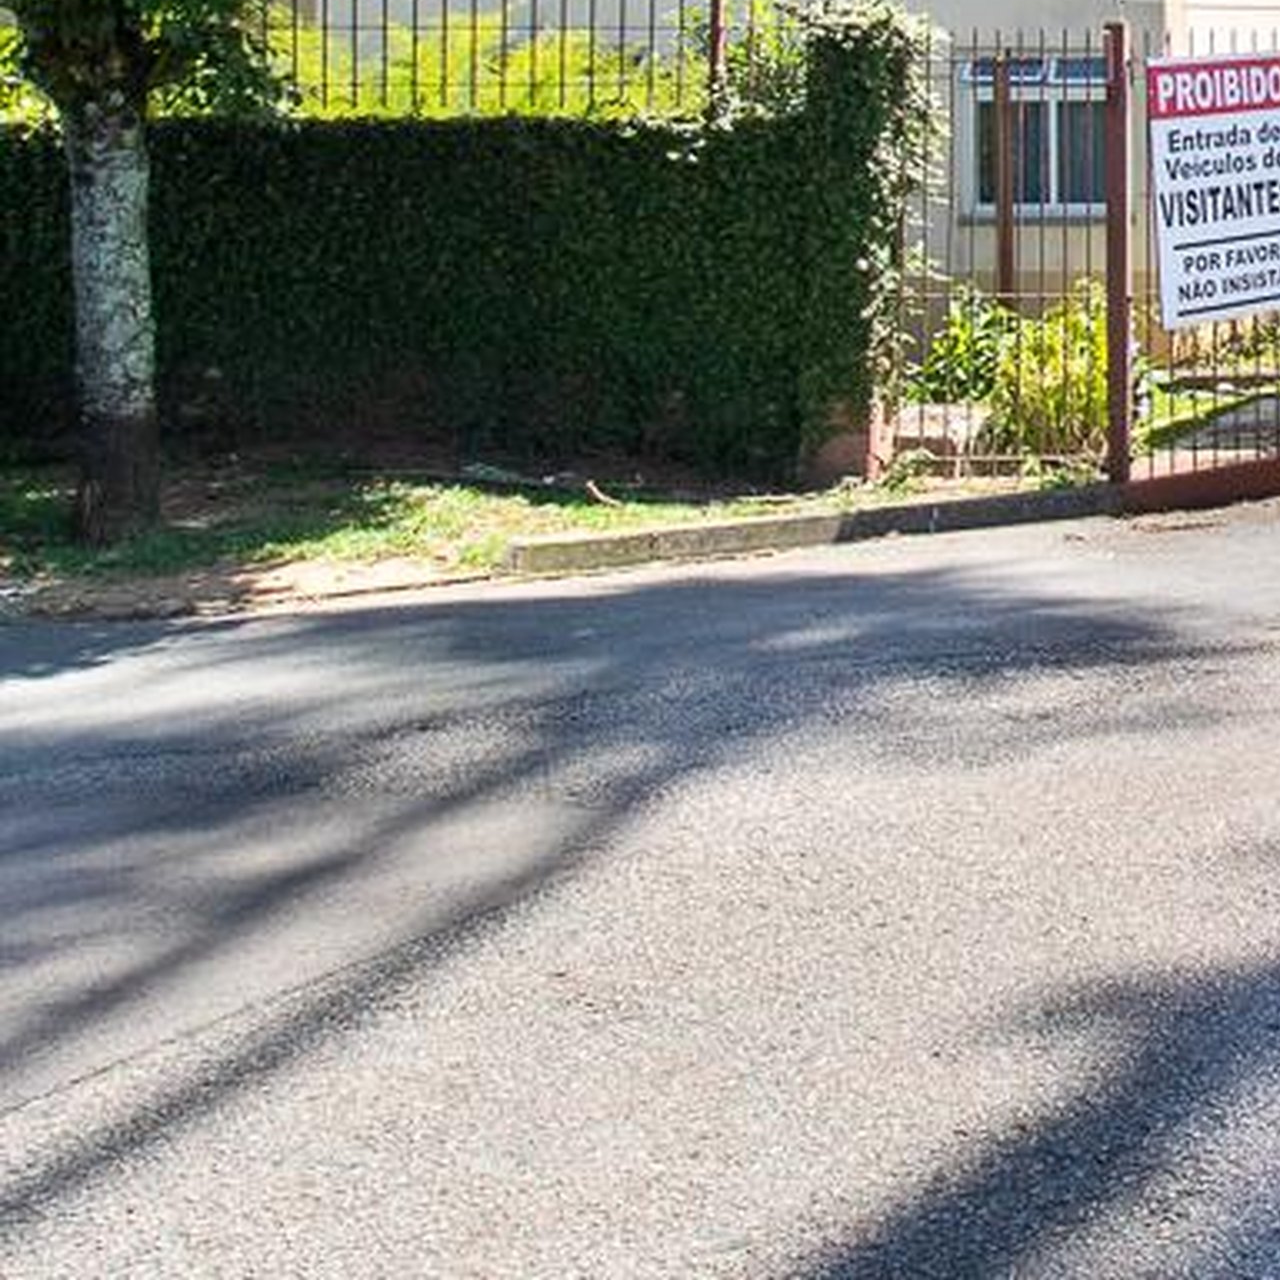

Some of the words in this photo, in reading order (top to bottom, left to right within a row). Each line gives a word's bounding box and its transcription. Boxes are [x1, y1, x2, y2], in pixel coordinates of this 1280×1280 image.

[1168, 124, 1251, 153] Entrada
[1257, 121, 1280, 144] de
[1183, 254, 1221, 273] POR
[1225, 243, 1280, 267] FAVOR
